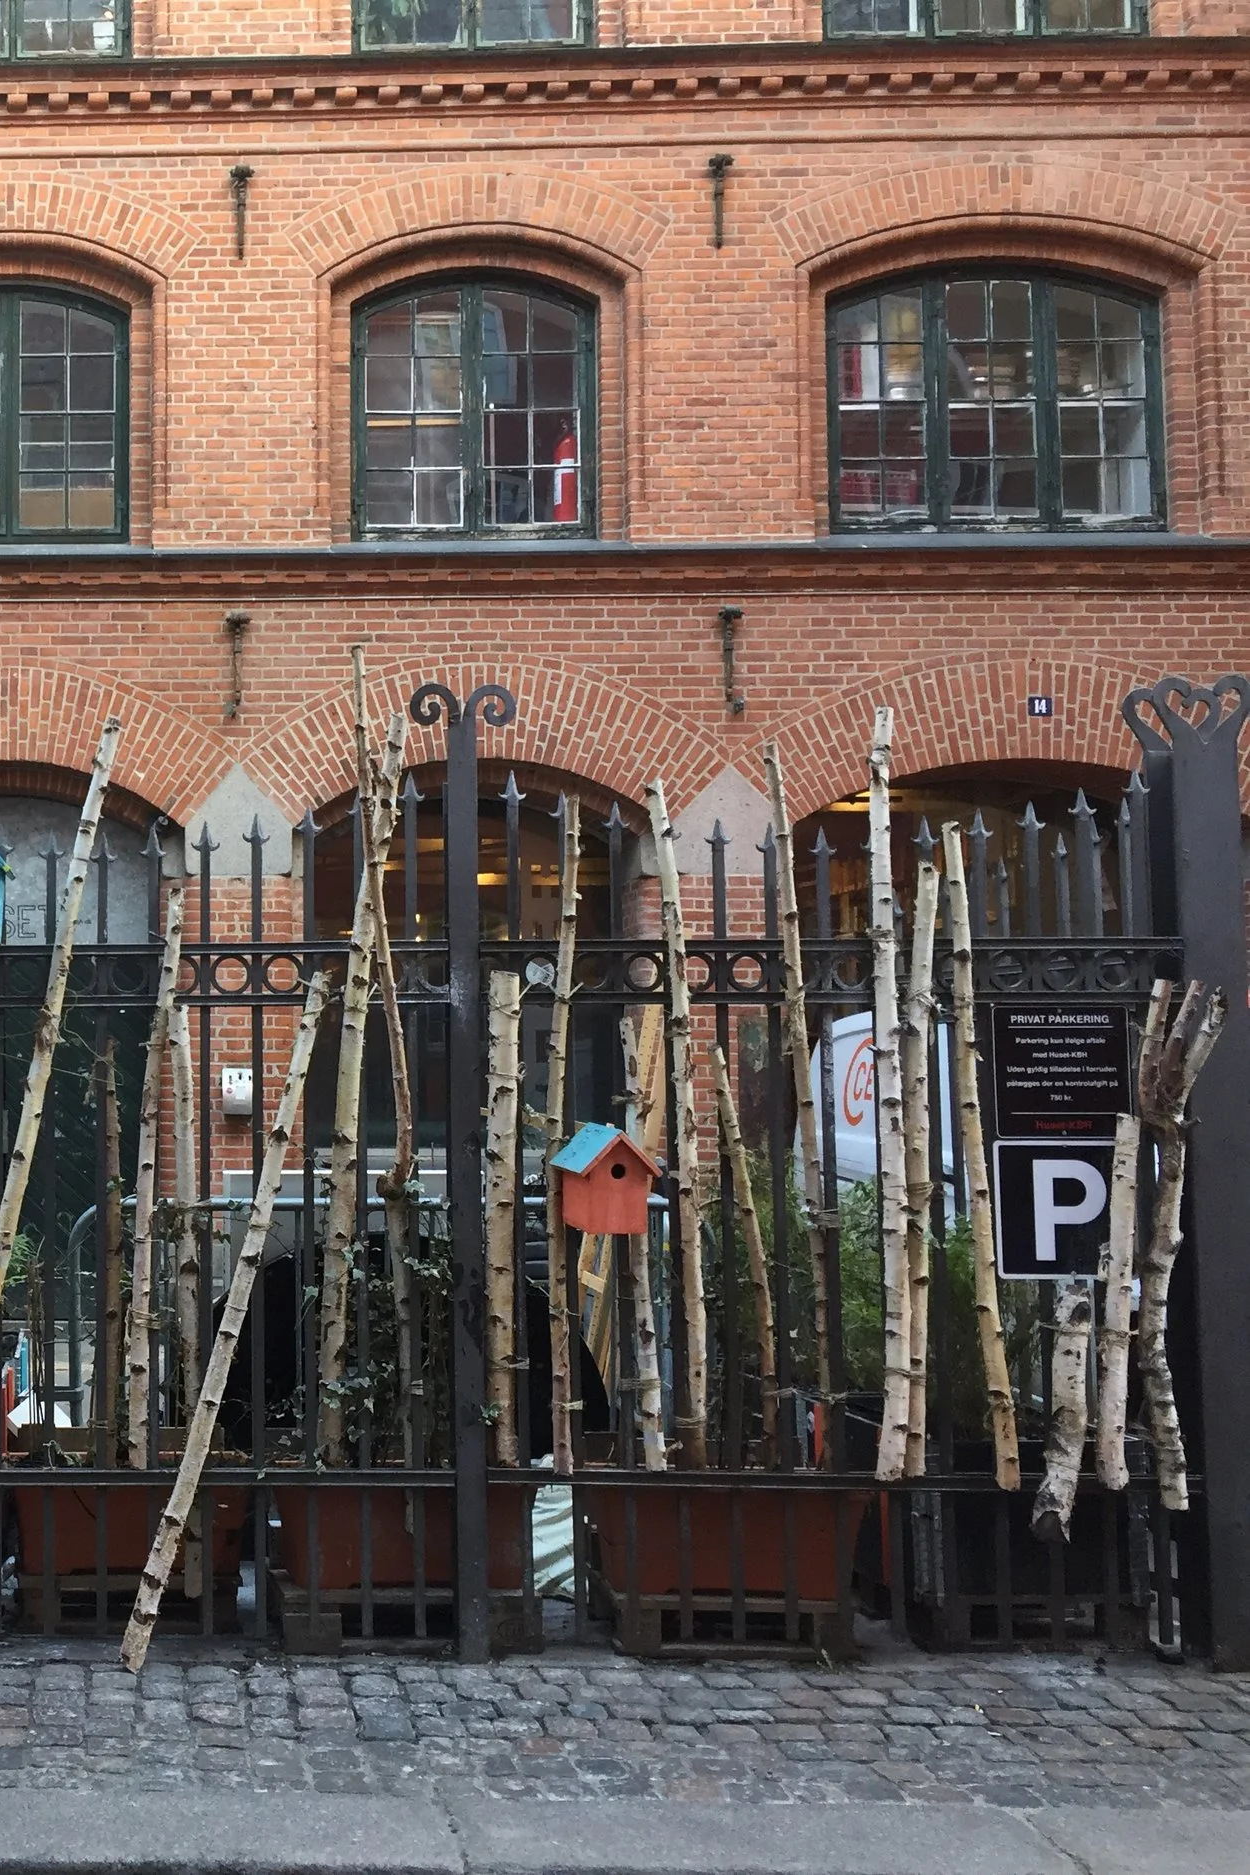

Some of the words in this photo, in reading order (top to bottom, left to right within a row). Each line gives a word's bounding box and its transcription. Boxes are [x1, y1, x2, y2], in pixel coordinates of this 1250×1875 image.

[1034, 699, 1047, 714] 14
[1010, 1015, 1046, 1024] PRIVAT
[1048, 1015, 1110, 1024] PARKERING
[1015, 1037, 1049, 1045] Parkering
[1032, 1159, 1107, 1262] P
